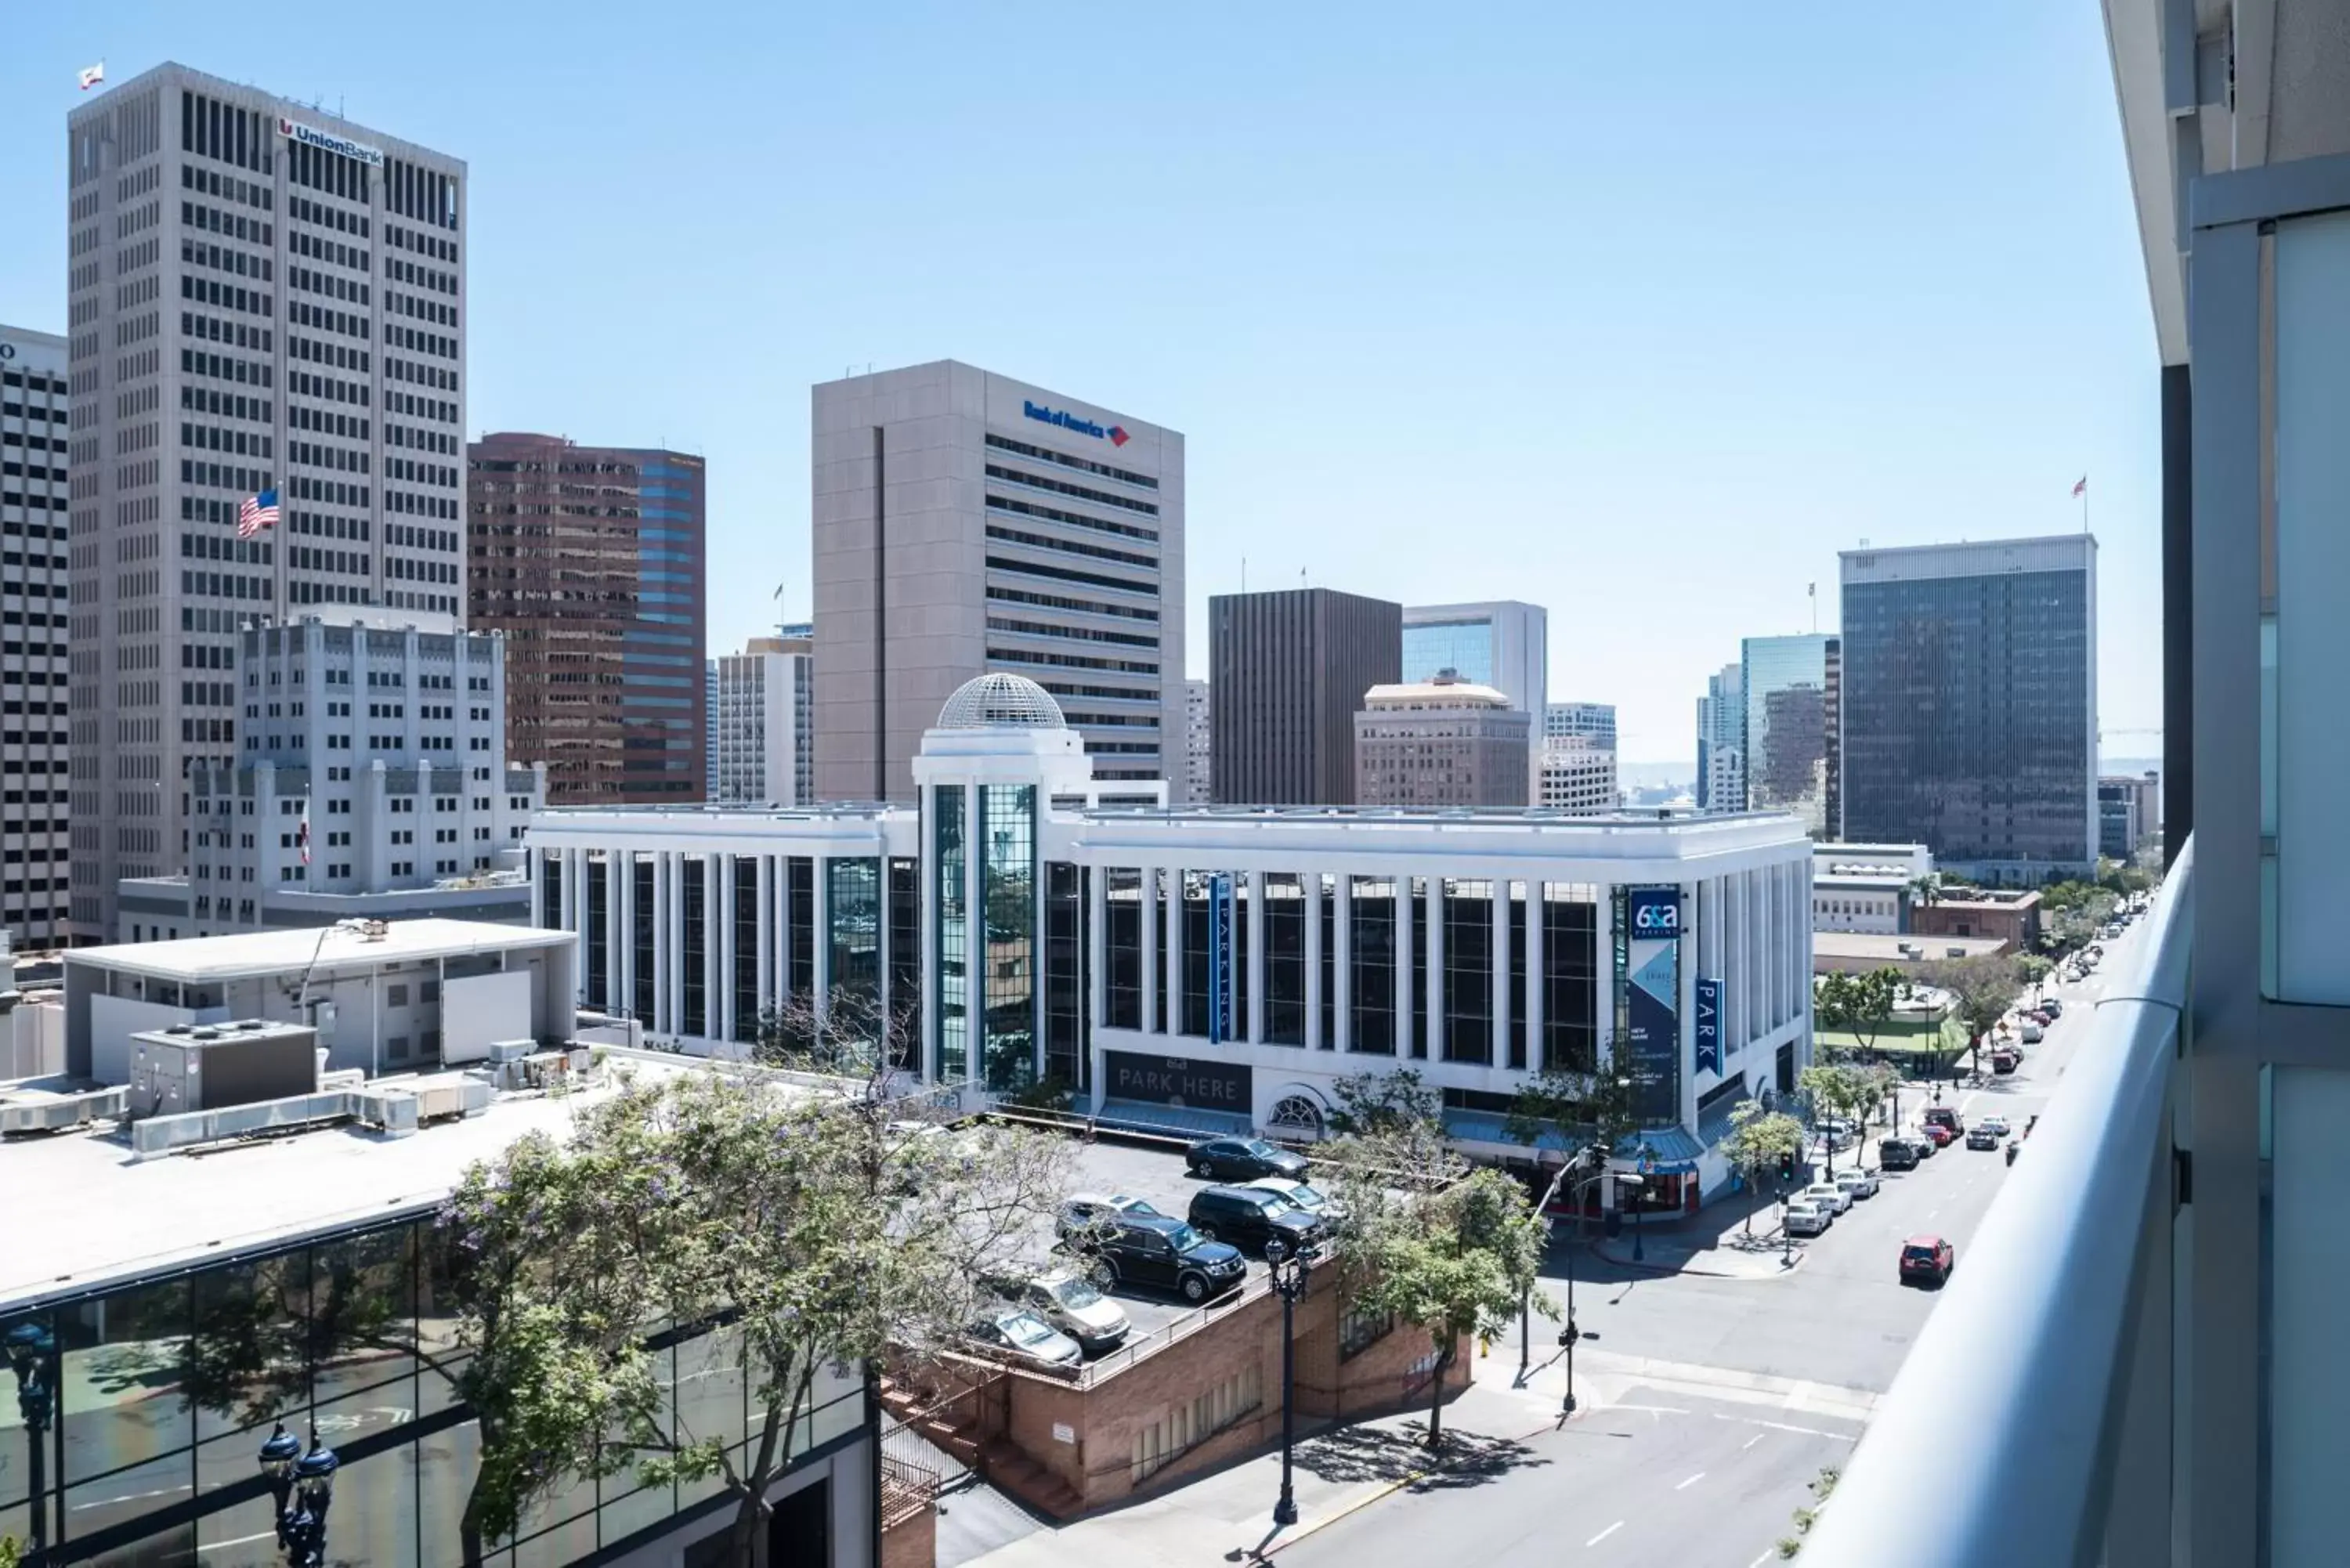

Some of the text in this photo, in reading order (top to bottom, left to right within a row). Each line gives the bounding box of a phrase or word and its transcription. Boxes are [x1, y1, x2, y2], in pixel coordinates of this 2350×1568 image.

[296, 125, 382, 164] UnionBank
[1636, 905, 1678, 928] 6&a
[1219, 907, 1230, 1027] PARKING
[1698, 986, 1716, 1057] PARK
[1119, 1068, 1238, 1100] PARK HERE
